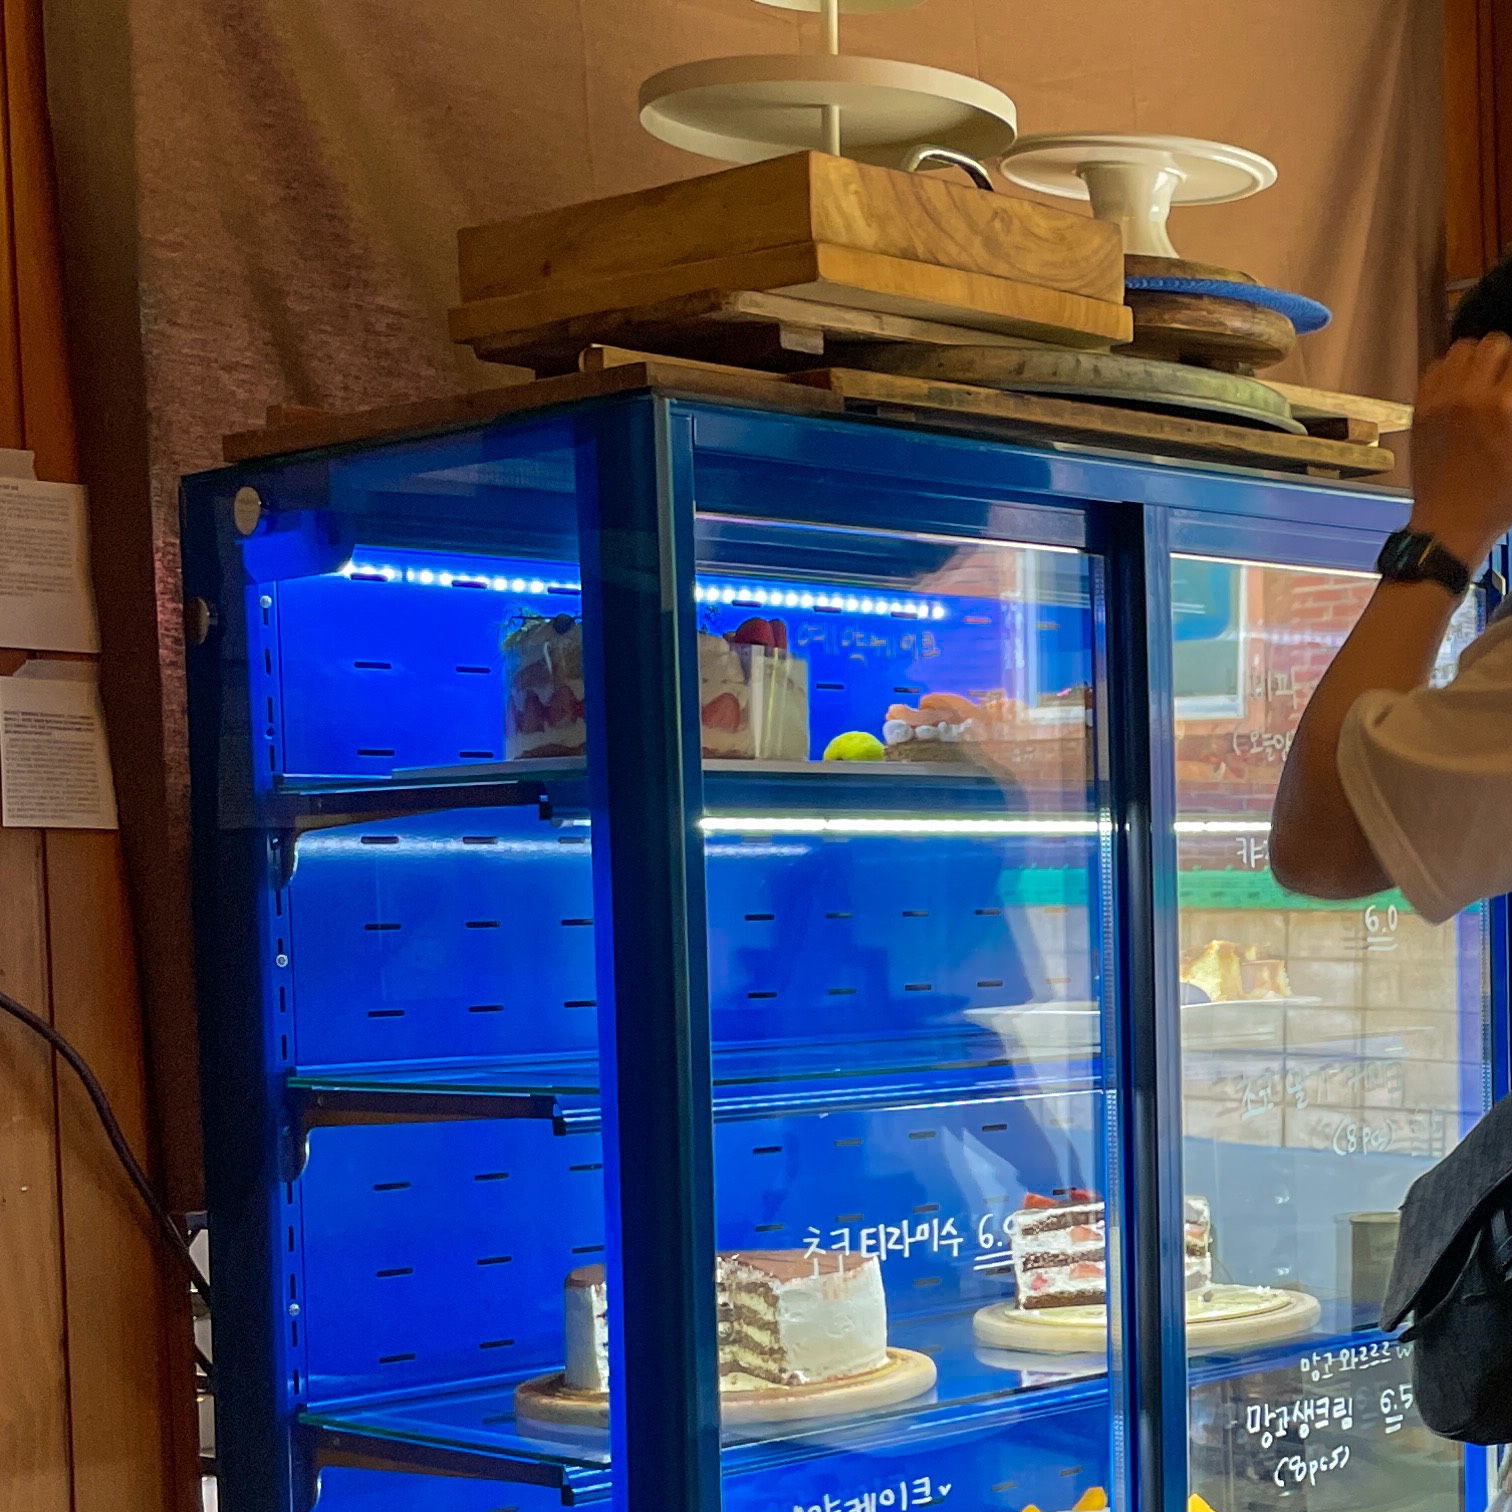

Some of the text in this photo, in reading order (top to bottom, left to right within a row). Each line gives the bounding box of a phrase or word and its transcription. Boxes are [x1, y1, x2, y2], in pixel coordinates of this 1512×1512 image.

[1364, 904, 1398, 933] 6.0
[1246, 1382, 1414, 1449] 망고생크림 6.5
[1274, 1445, 1350, 1487] (8pcs)
